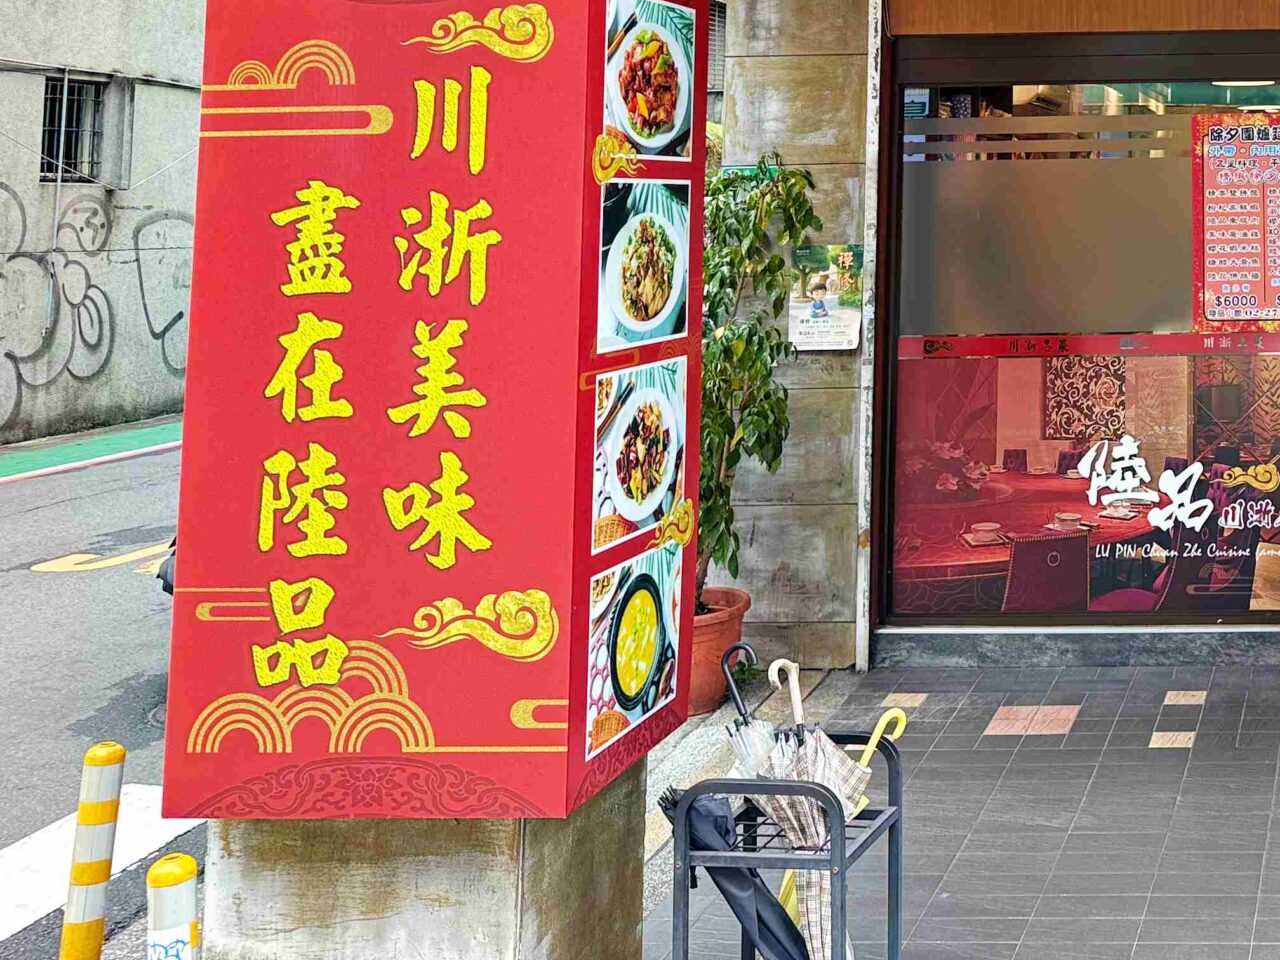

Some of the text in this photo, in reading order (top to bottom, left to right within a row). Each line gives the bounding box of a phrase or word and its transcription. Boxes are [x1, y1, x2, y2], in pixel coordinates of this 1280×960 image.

[383, 65, 502, 570] 川浙美味
[1215, 295, 1257, 307] $6000
[252, 180, 361, 688] 盡在陸品
[1077, 435, 1215, 533] 陸品
[1095, 543, 1110, 559] LU
[1115, 542, 1138, 559] PIN
[1141, 542, 1179, 558] Chuan
[1183, 542, 1202, 557] Zhe
[1206, 543, 1251, 557] Cuisine
